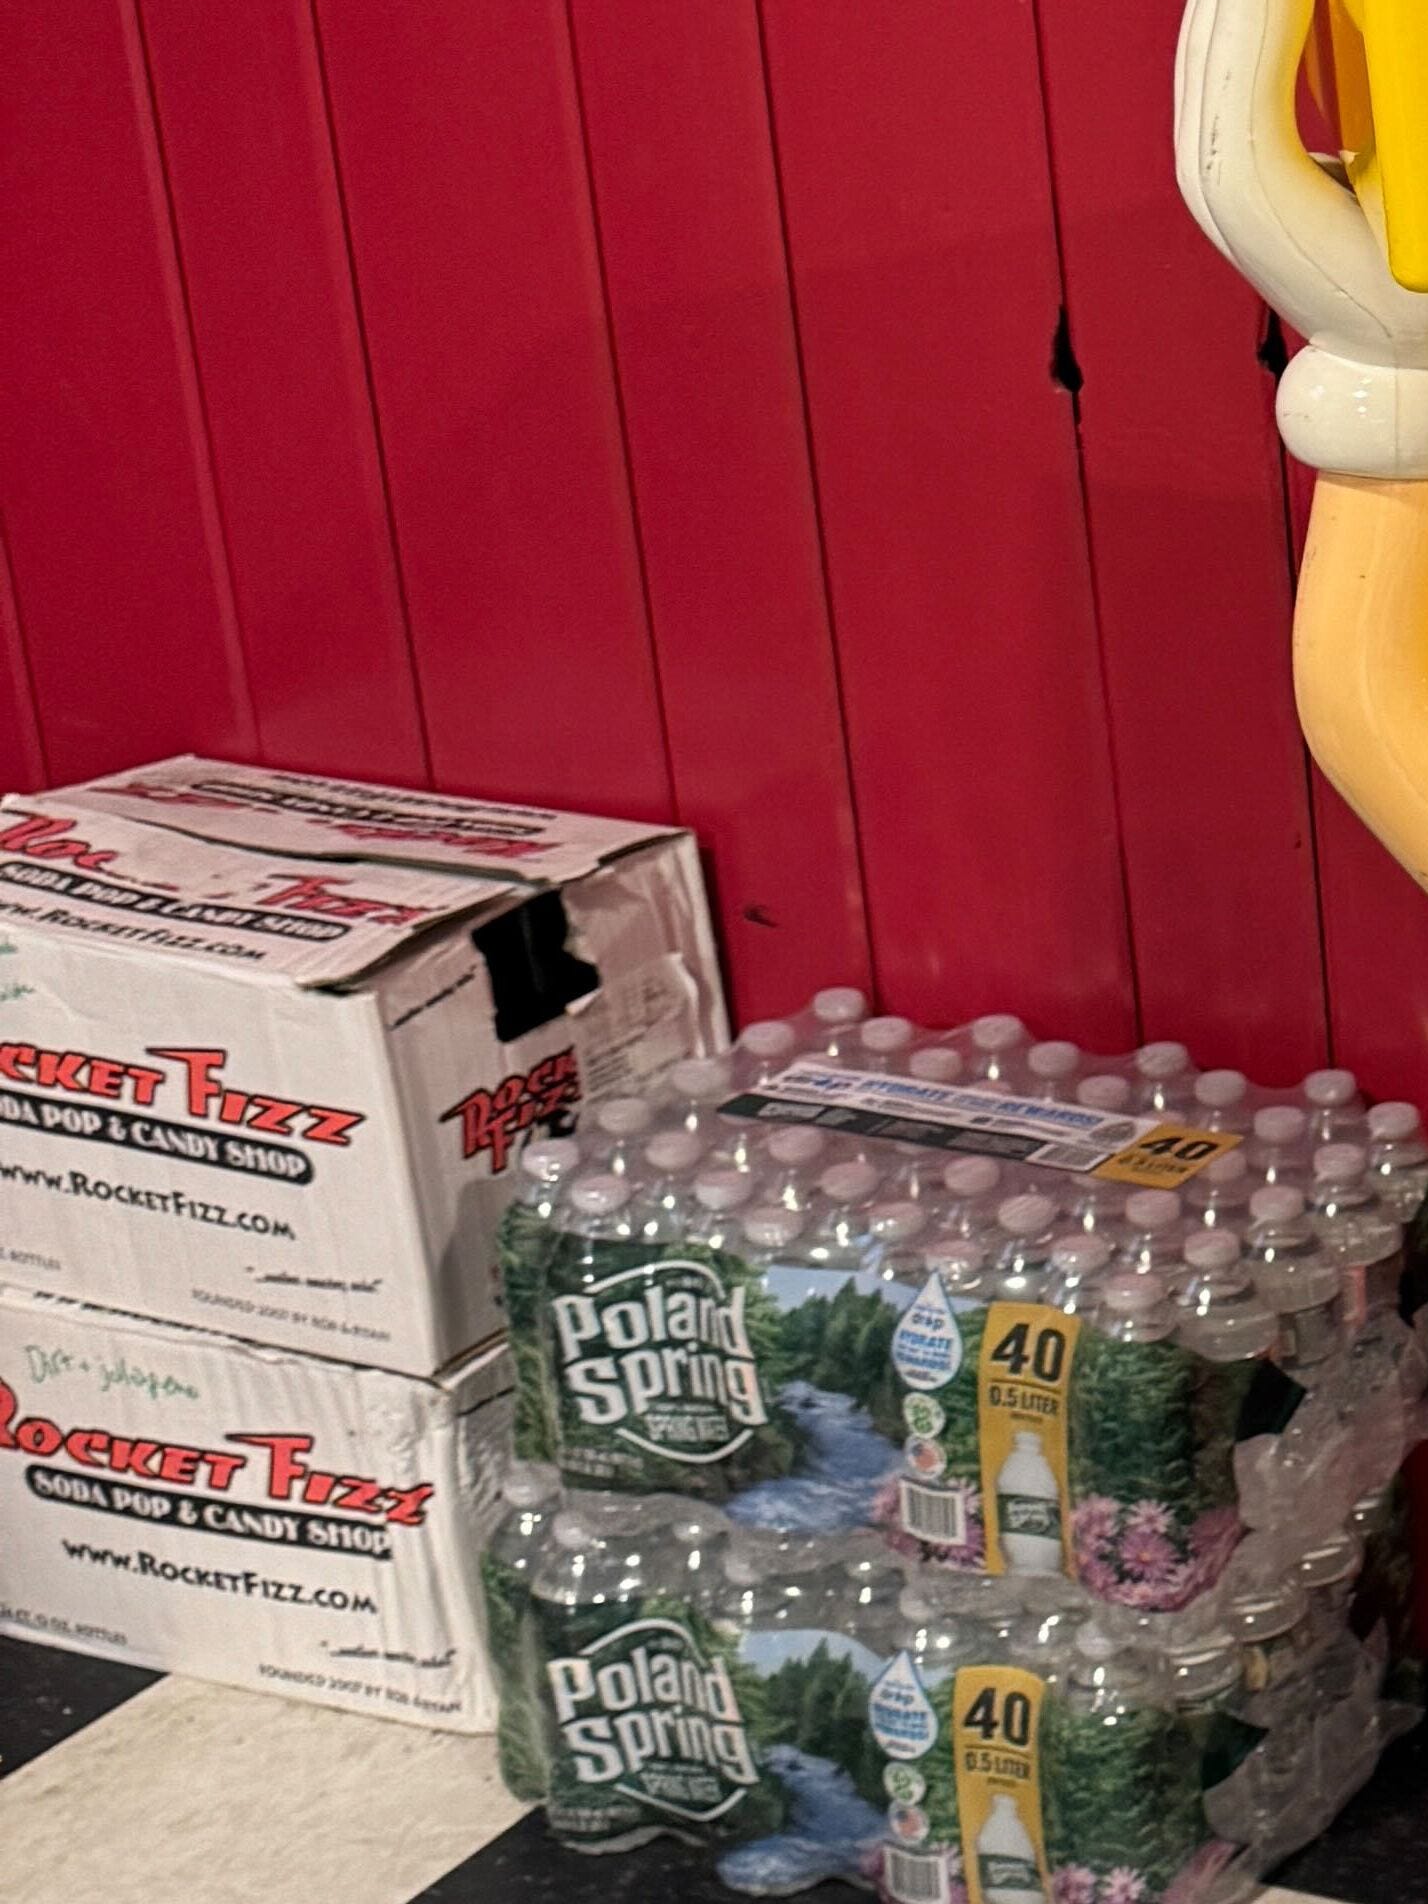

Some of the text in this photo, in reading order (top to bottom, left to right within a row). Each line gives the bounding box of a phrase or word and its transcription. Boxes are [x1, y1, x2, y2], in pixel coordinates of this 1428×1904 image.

[0, 1043, 165, 1105] CKET
[439, 1044, 579, 1159] ROCK
[41, 1102, 306, 1178] POP & CANDY SHOP
[1140, 1135, 1219, 1164] 40
[552, 1285, 755, 1362] Poland
[991, 1322, 1066, 1382] 40
[564, 1342, 769, 1426] Spring
[988, 1386, 1059, 1417] 0.5 LITER
[33, 1470, 393, 1558] SODA POP & CANDY SHOP
[224, 1432, 435, 1526] FIZZ
[546, 1646, 744, 1724] Poland
[963, 1686, 1032, 1749] 40
[561, 1704, 760, 1786] Spring
[964, 1751, 991, 1774] 0.5
